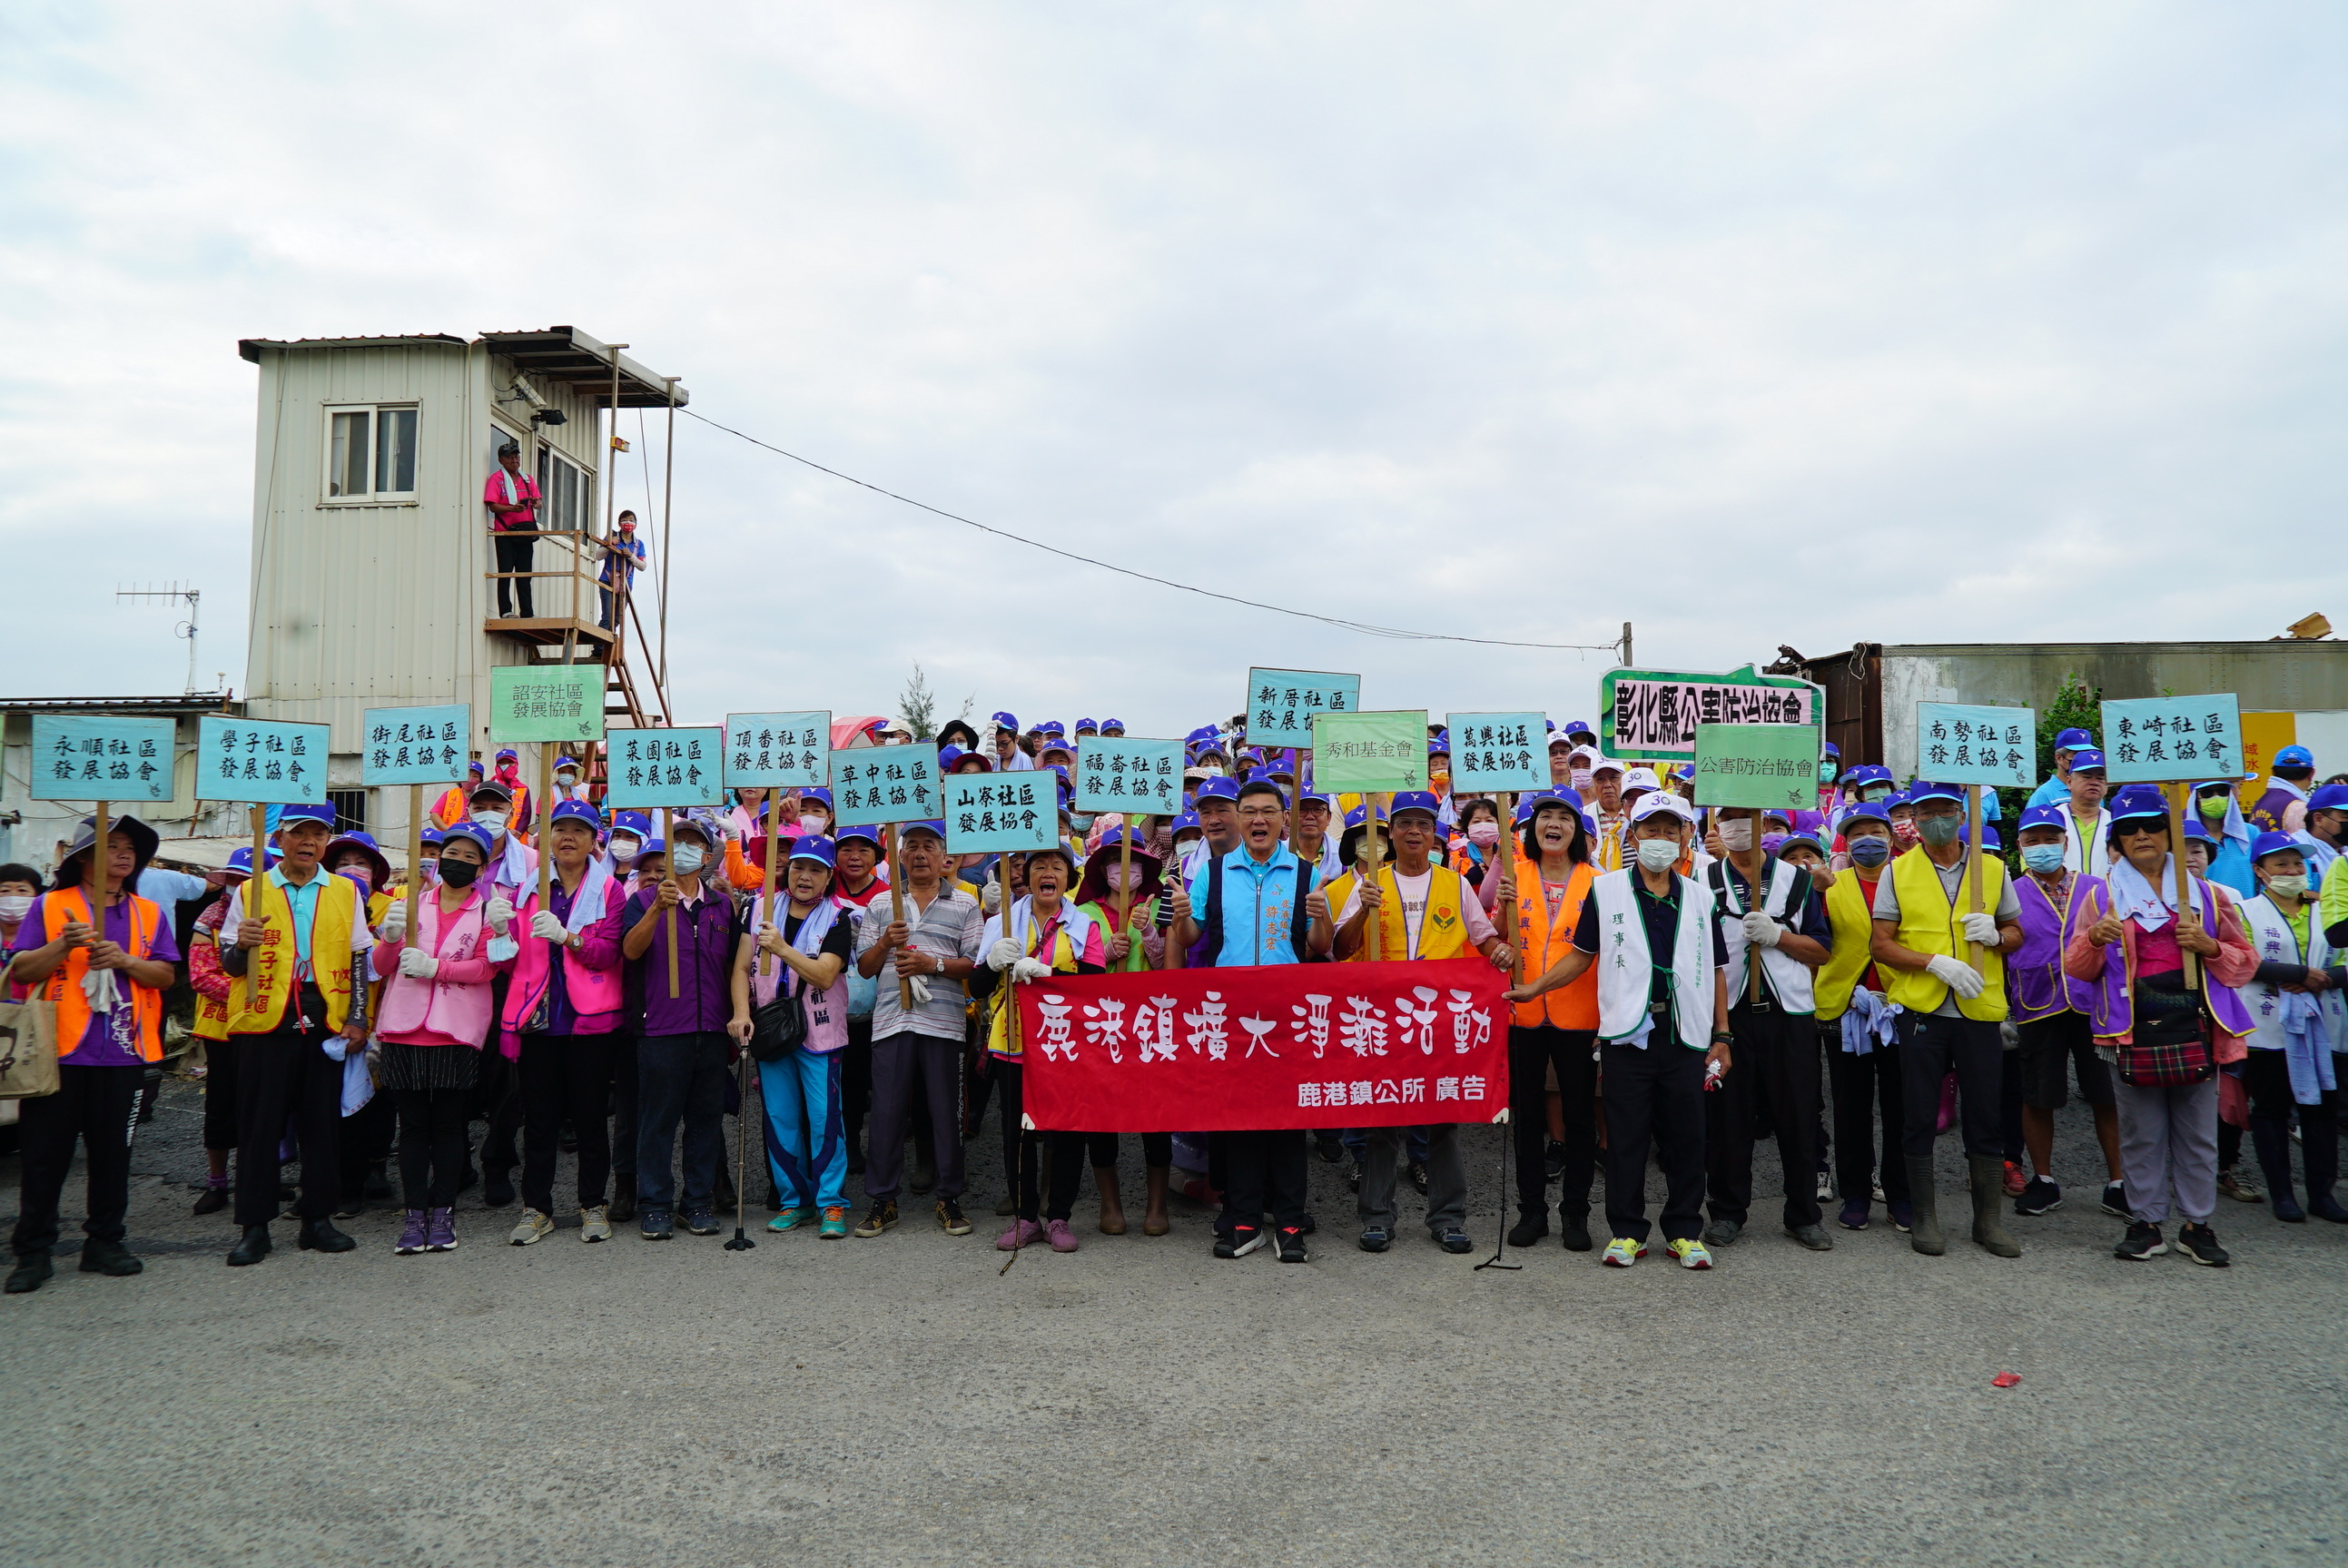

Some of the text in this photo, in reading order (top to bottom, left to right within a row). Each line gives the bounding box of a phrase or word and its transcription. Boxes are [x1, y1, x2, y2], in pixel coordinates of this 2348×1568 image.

[513, 683, 583, 702] 詔安社區
[1258, 685, 1345, 710] 新厝社區
[513, 701, 583, 719] 發展協會
[1257, 709, 1313, 732] 發展
[372, 723, 457, 745] 街尾社區
[1464, 725, 1530, 747] 萬興社區
[1929, 720, 2021, 745] 南勢社區
[2116, 713, 2224, 738] 東崎社區
[53, 735, 156, 757] 永順社區
[220, 730, 306, 756] 學子社區
[736, 729, 817, 748] 頂番社區
[1326, 740, 1414, 759] 秀和基金會
[2116, 737, 2228, 764] 發展協會
[372, 745, 458, 769] 發展協會
[626, 739, 703, 763] 菜園社區
[733, 750, 818, 772] 發展協會
[1463, 750, 1533, 773] 發展協會
[1928, 744, 2024, 769] 發展協會
[52, 759, 159, 782] 發展協會
[219, 756, 306, 783] 發展協會
[626, 764, 703, 787] 發展協會
[841, 761, 928, 784] 草中社區
[1700, 756, 1812, 777] 公害防治協會
[843, 784, 931, 810] 發展協會
[958, 784, 1035, 808] 山寮社區
[1086, 775, 1173, 799] 發展協會
[959, 809, 1038, 834] 發展協會
[1265, 905, 1278, 951] 許志宏
[1612, 912, 1625, 969] 理事長
[1037, 986, 1491, 1064] 鹿港鎮擴大淨灘活動
[1298, 1074, 1486, 1108] 鹿港鎮公所 廣告
